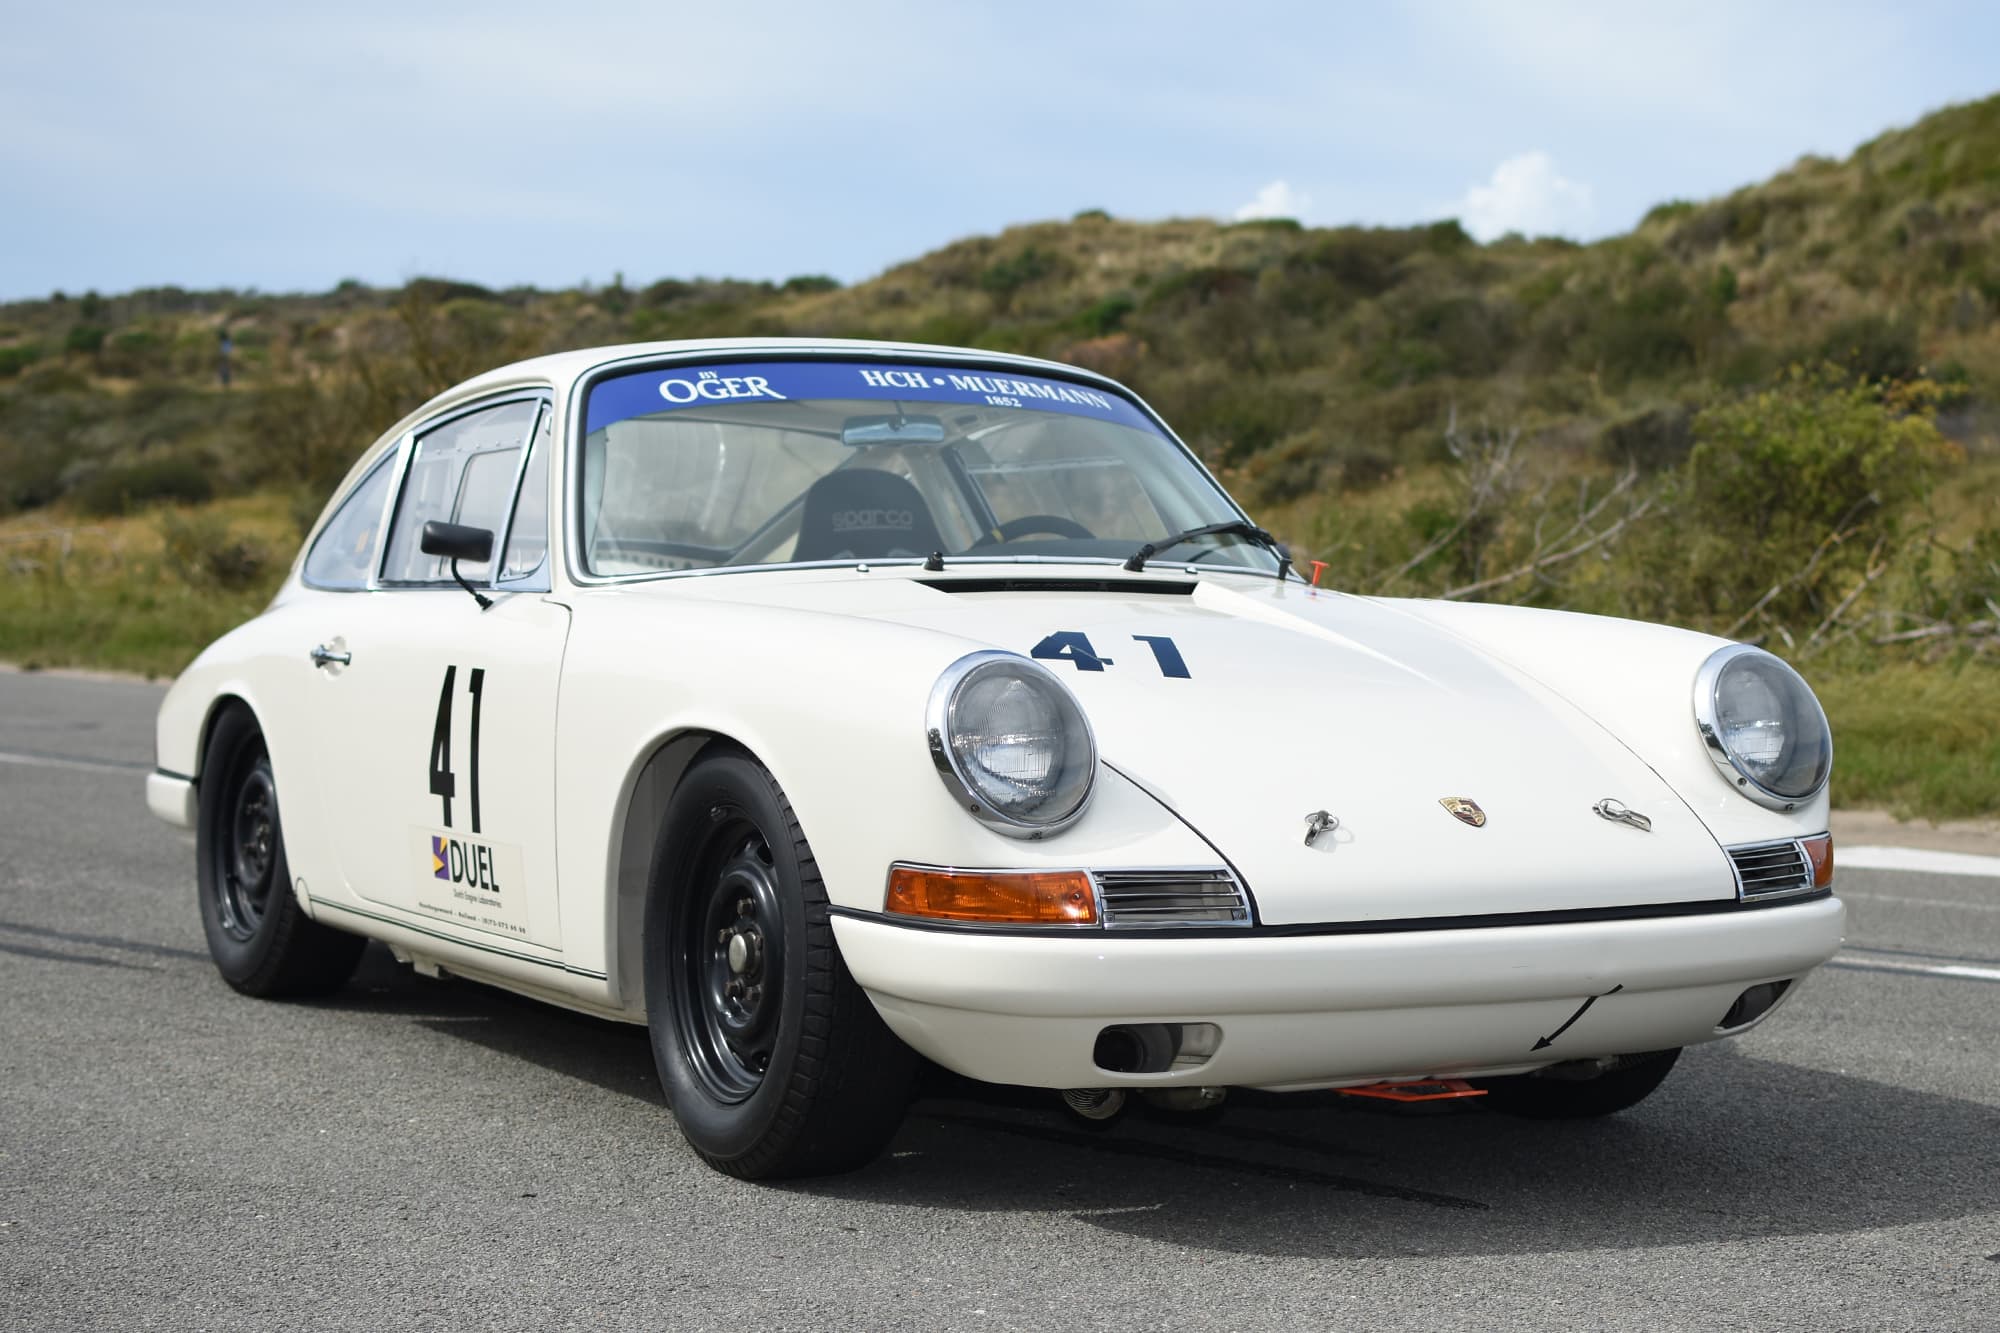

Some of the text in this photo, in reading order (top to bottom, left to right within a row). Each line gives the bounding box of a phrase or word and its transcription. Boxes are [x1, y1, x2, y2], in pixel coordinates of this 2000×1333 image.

[658, 376, 788, 404] OGER
[698, 370, 718, 380] BY
[858, 369, 1113, 411] HCH MUERMANN
[984, 395, 1023, 408] 1852
[1030, 630, 1193, 679] 41
[429, 664, 486, 834] 41
[449, 838, 500, 894] DUEL
